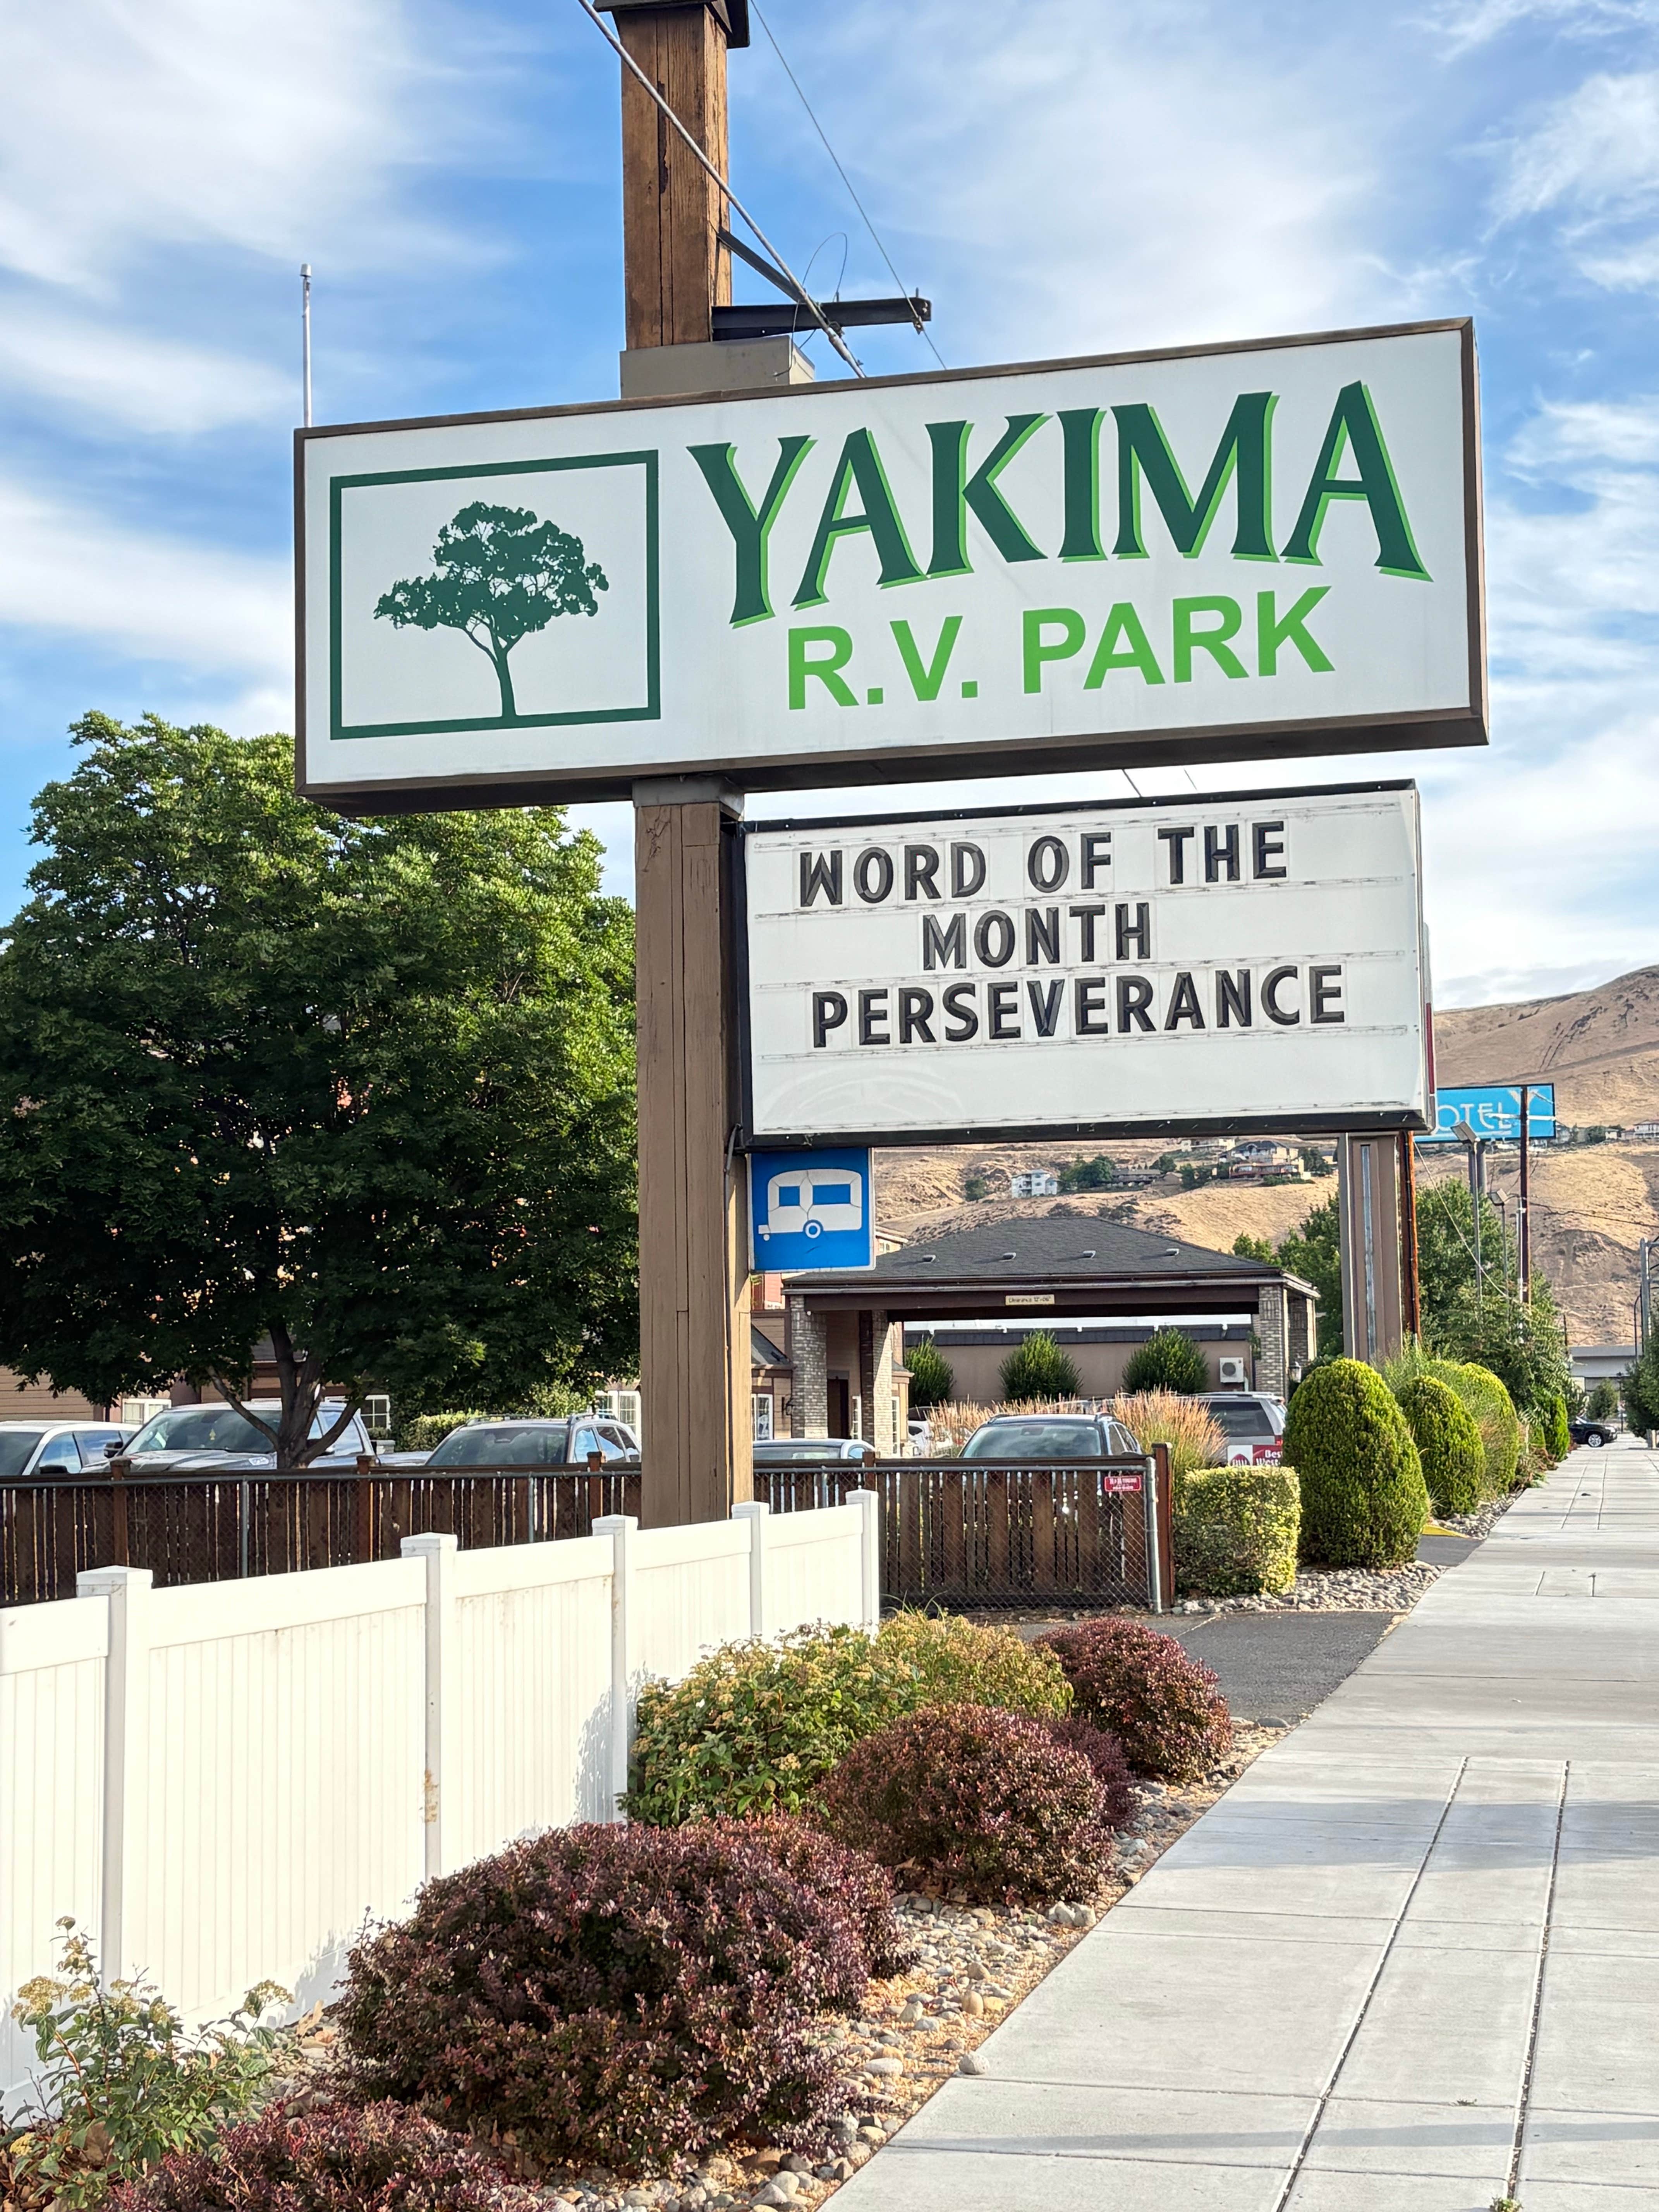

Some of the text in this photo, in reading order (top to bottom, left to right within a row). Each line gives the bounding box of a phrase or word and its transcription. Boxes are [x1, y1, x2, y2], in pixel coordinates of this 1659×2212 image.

[686, 380, 1432, 628] YAKIMA
[788, 587, 1334, 709] R.V. PARK
[800, 821, 1287, 907] WORD OF THE
[923, 902, 1151, 970] MONTH
[812, 965, 1345, 1048] PERSEVERANCE
[1436, 1102, 1512, 1131] OTEL
